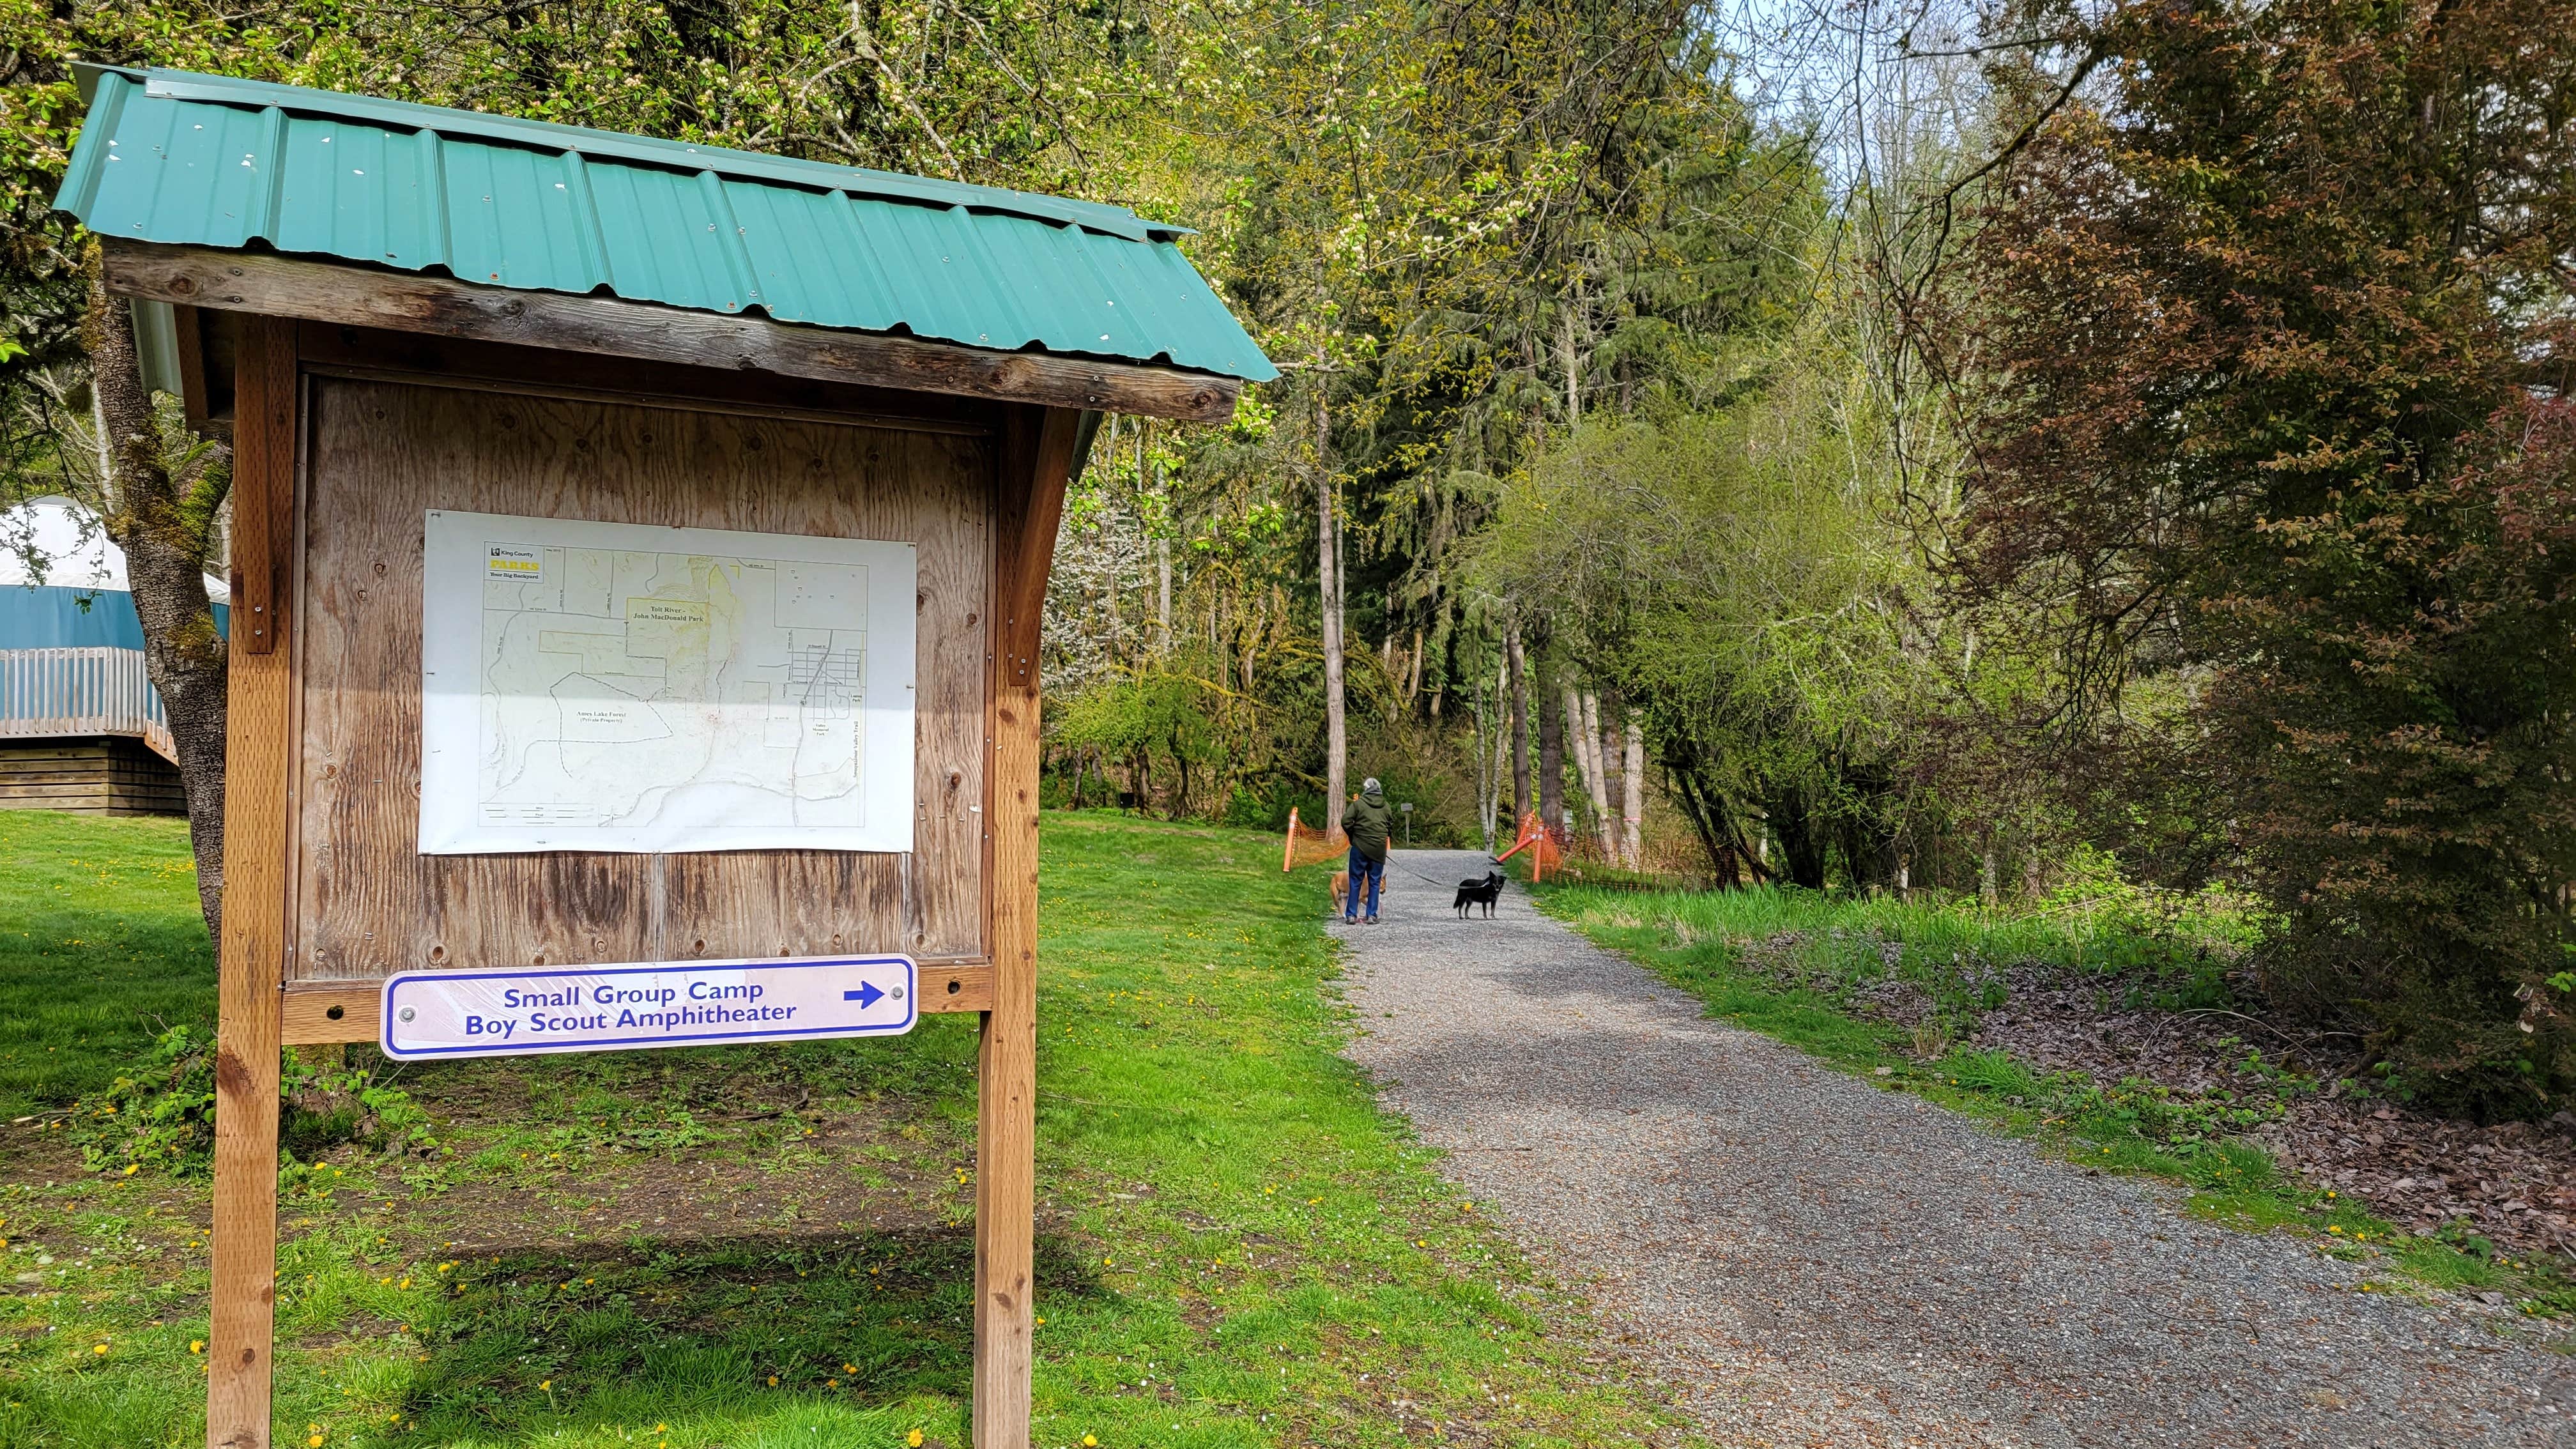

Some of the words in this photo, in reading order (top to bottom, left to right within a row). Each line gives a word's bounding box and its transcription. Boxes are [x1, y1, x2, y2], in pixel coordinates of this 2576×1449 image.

[490, 558, 539, 571] PARKS
[504, 986, 579, 1008] Small
[593, 985, 676, 1007] Group
[688, 981, 763, 1004] Camp
[466, 1015, 518, 1039] Boy
[530, 1012, 608, 1032] Scout
[616, 1005, 797, 1031] Amphitheater
